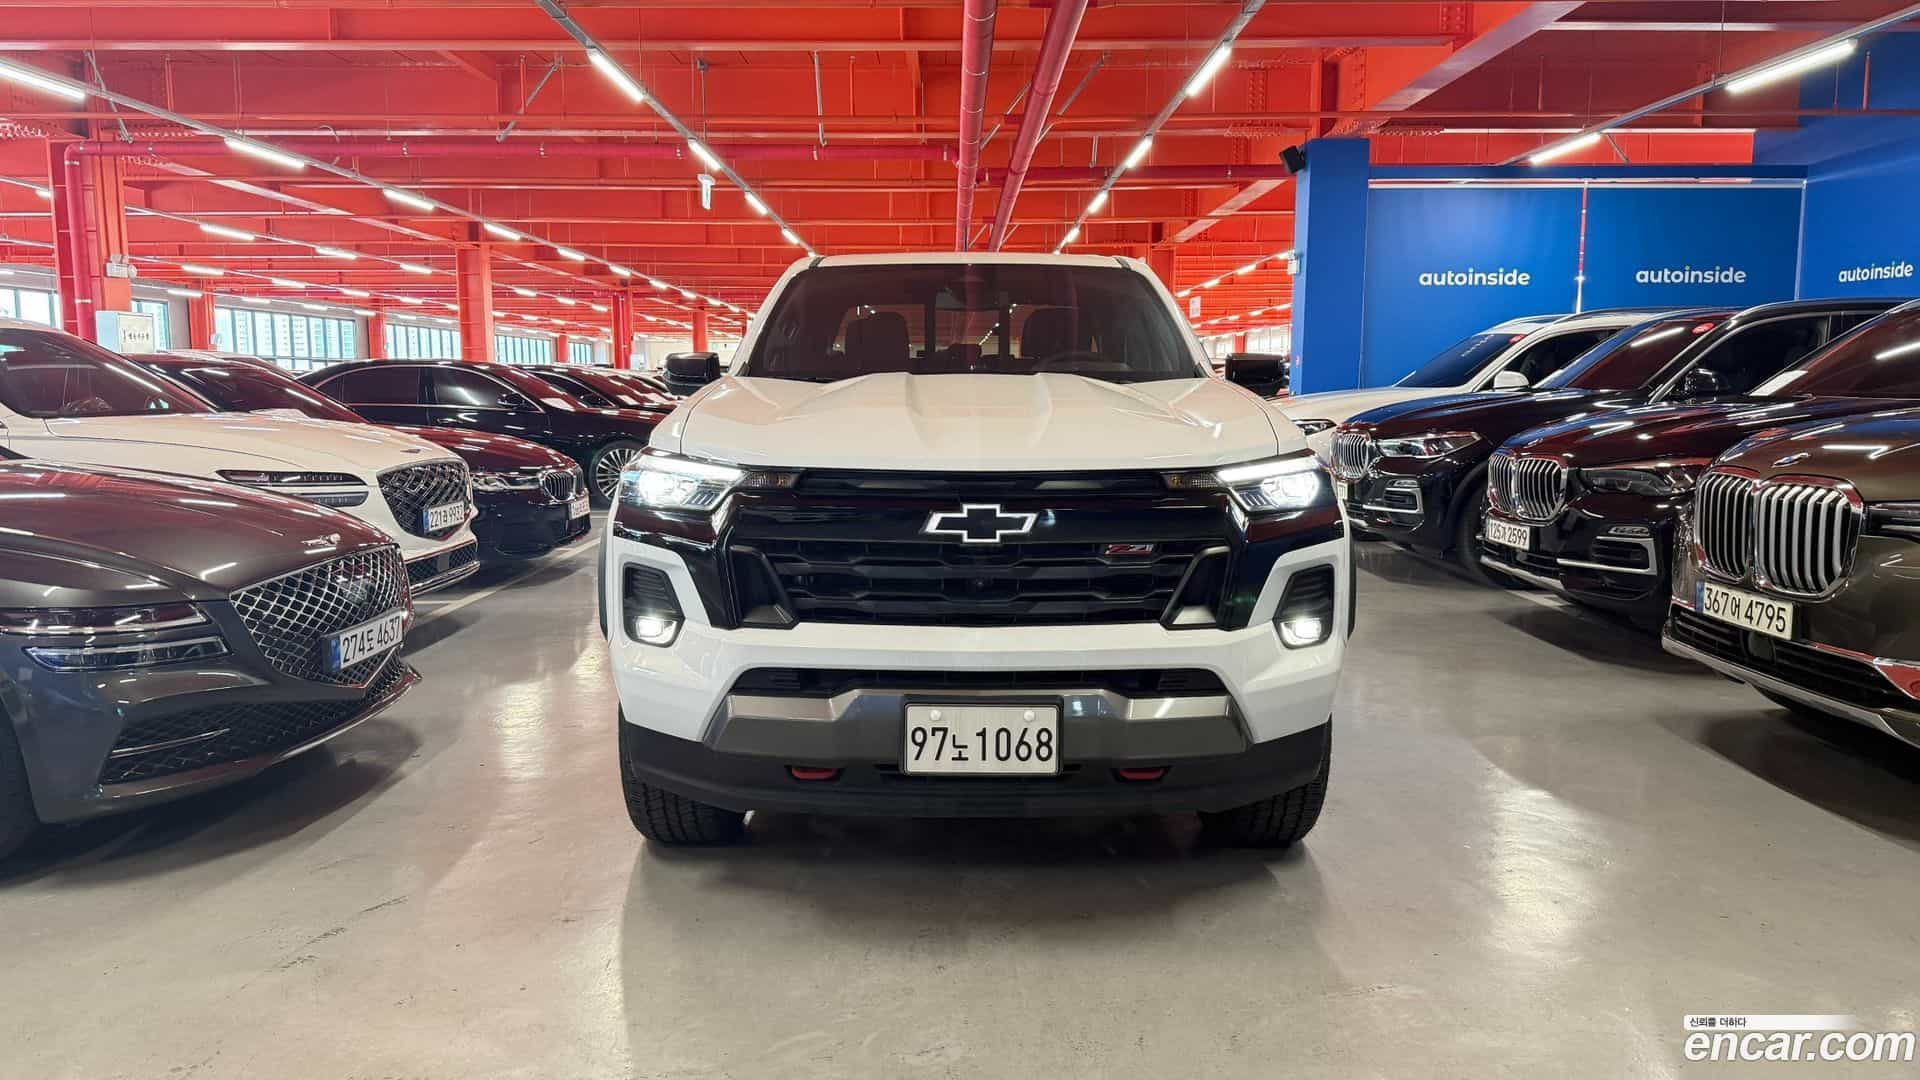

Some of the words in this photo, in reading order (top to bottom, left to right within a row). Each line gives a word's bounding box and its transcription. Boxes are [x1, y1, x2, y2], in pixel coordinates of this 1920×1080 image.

[1419, 267, 1531, 286] autoinside
[1635, 266, 1747, 284] autoinside
[1838, 260, 1914, 283] autoinside
[1507, 526, 1528, 547] 2599
[1704, 587, 1741, 620] 367어
[1744, 600, 1787, 633] 4795
[376, 615, 401, 647] 4637
